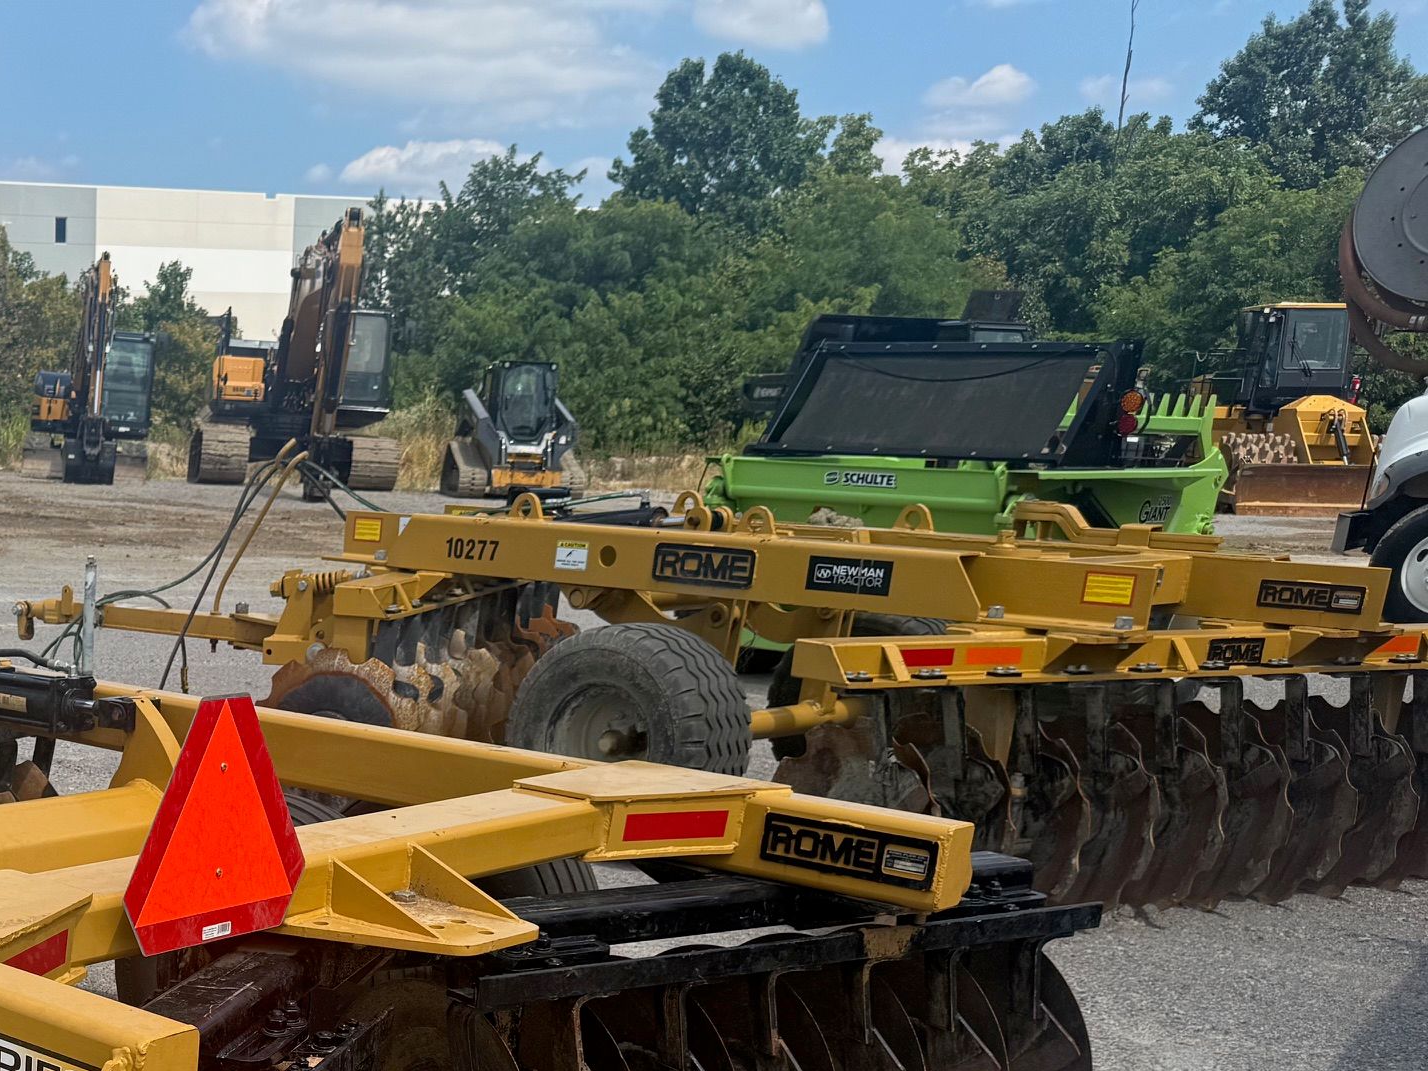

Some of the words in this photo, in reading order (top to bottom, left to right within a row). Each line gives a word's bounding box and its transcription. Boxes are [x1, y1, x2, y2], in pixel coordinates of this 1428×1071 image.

[842, 472, 895, 486] SCHULTE
[445, 536, 500, 561] 10277
[658, 548, 750, 580] ROME
[832, 564, 885, 578] NEWMAN
[832, 574, 883, 588] TRACTOR
[1262, 585, 1330, 606] ROME
[1209, 641, 1262, 664] ROME
[770, 825, 877, 869] ROME
